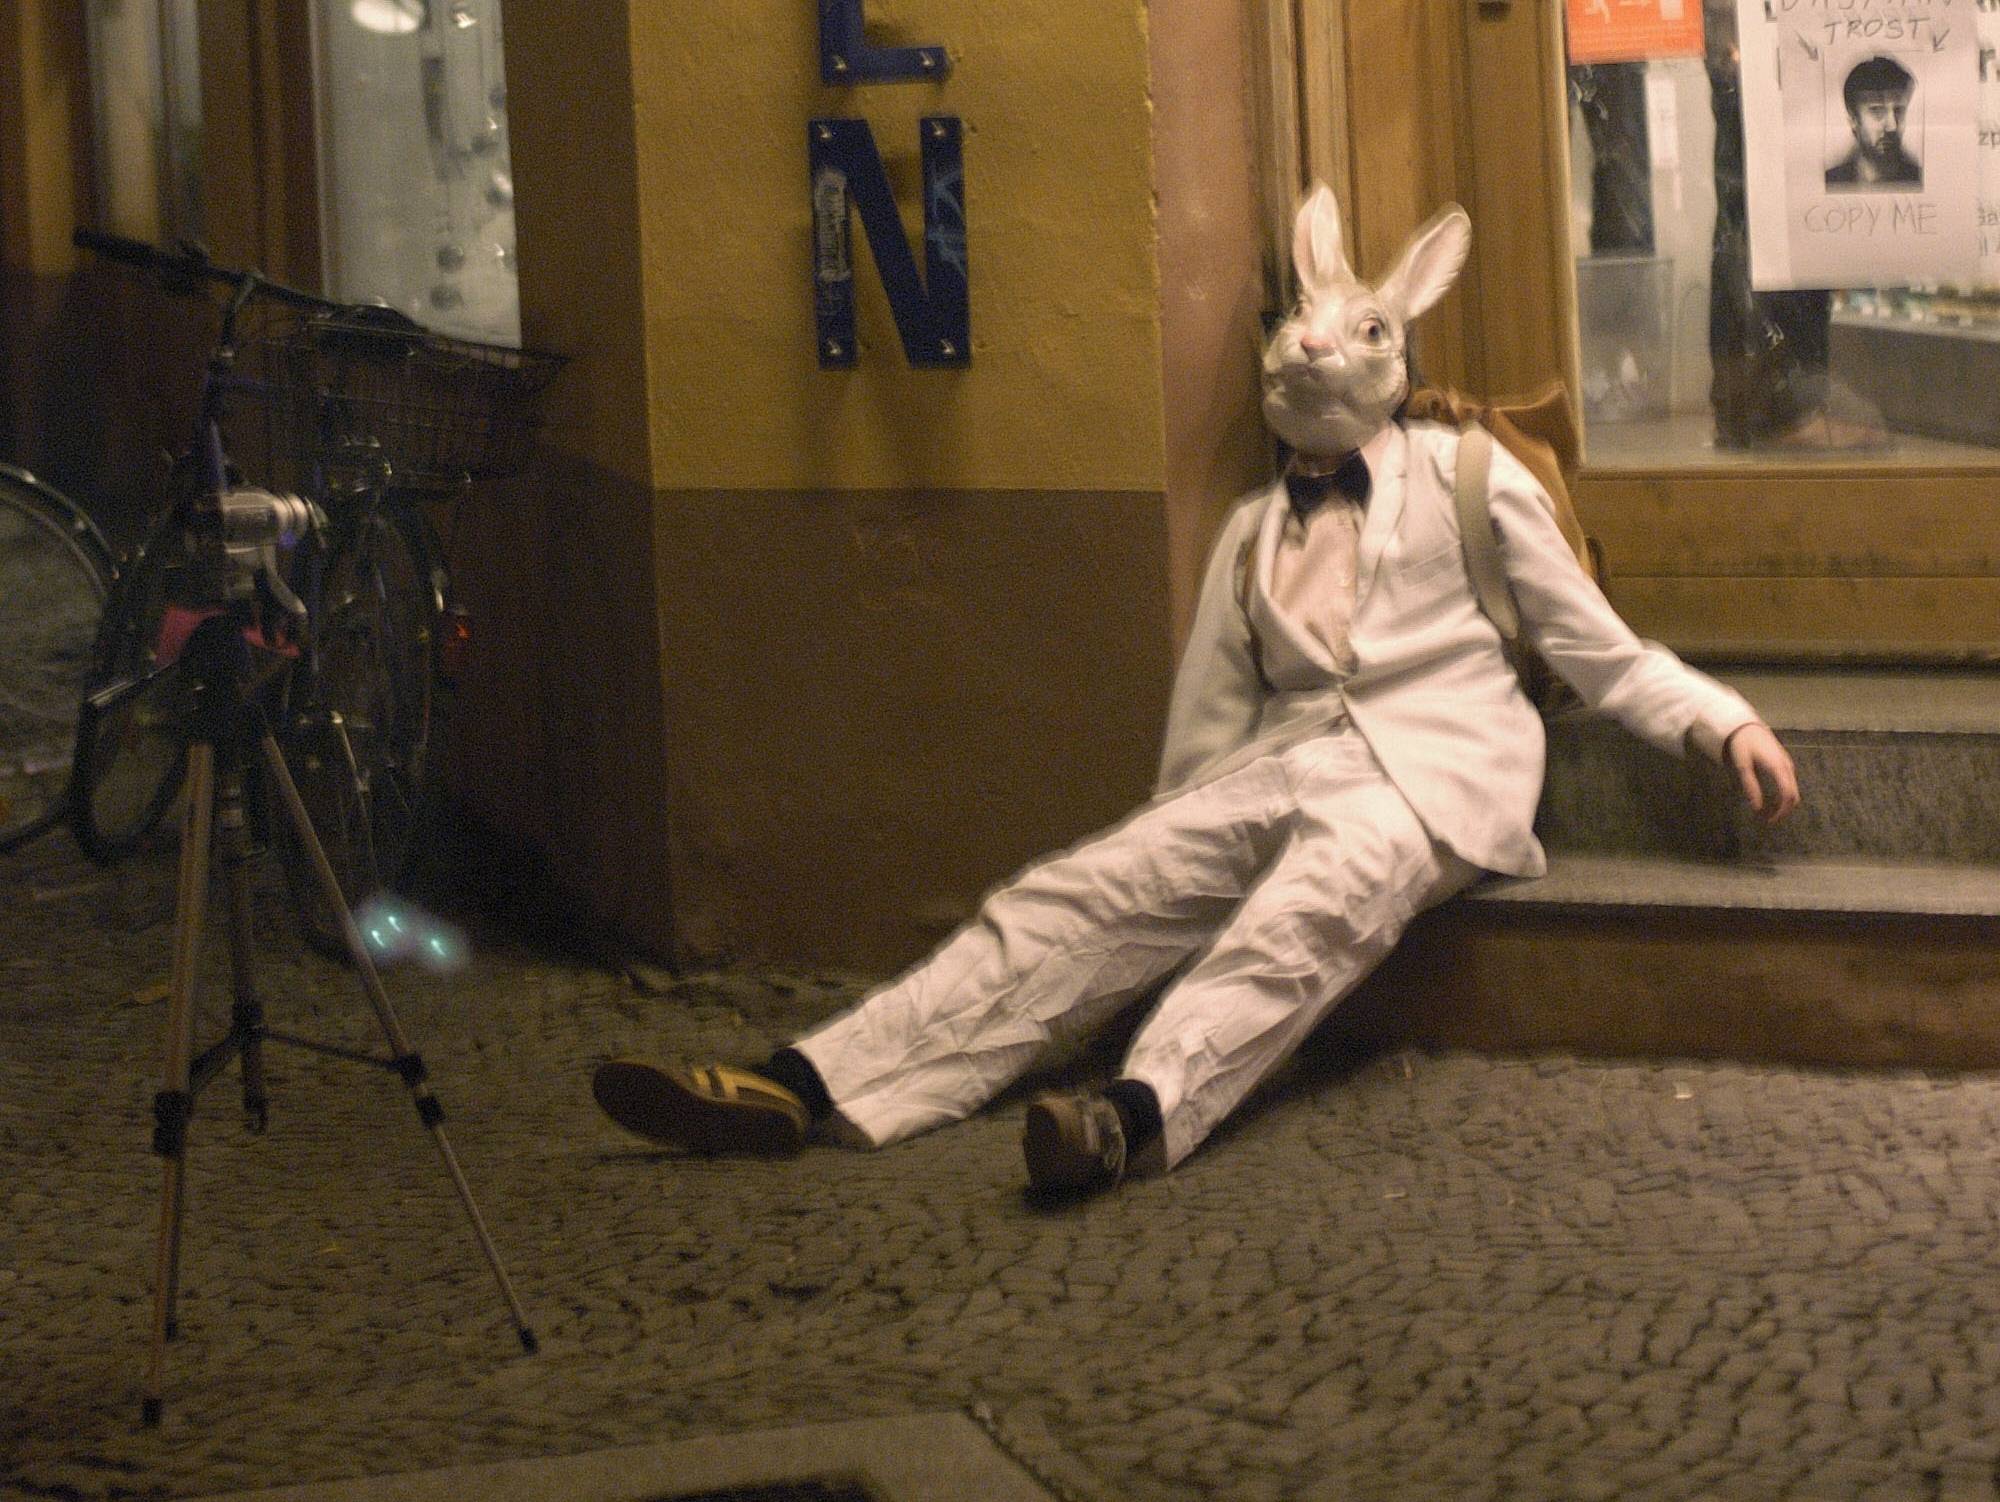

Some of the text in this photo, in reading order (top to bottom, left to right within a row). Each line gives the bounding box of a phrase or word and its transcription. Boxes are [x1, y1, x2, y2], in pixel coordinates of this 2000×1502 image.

[1824, 17, 1931, 45] TROST
[1804, 200, 1882, 237] COPY
[1893, 200, 1938, 235] ME
